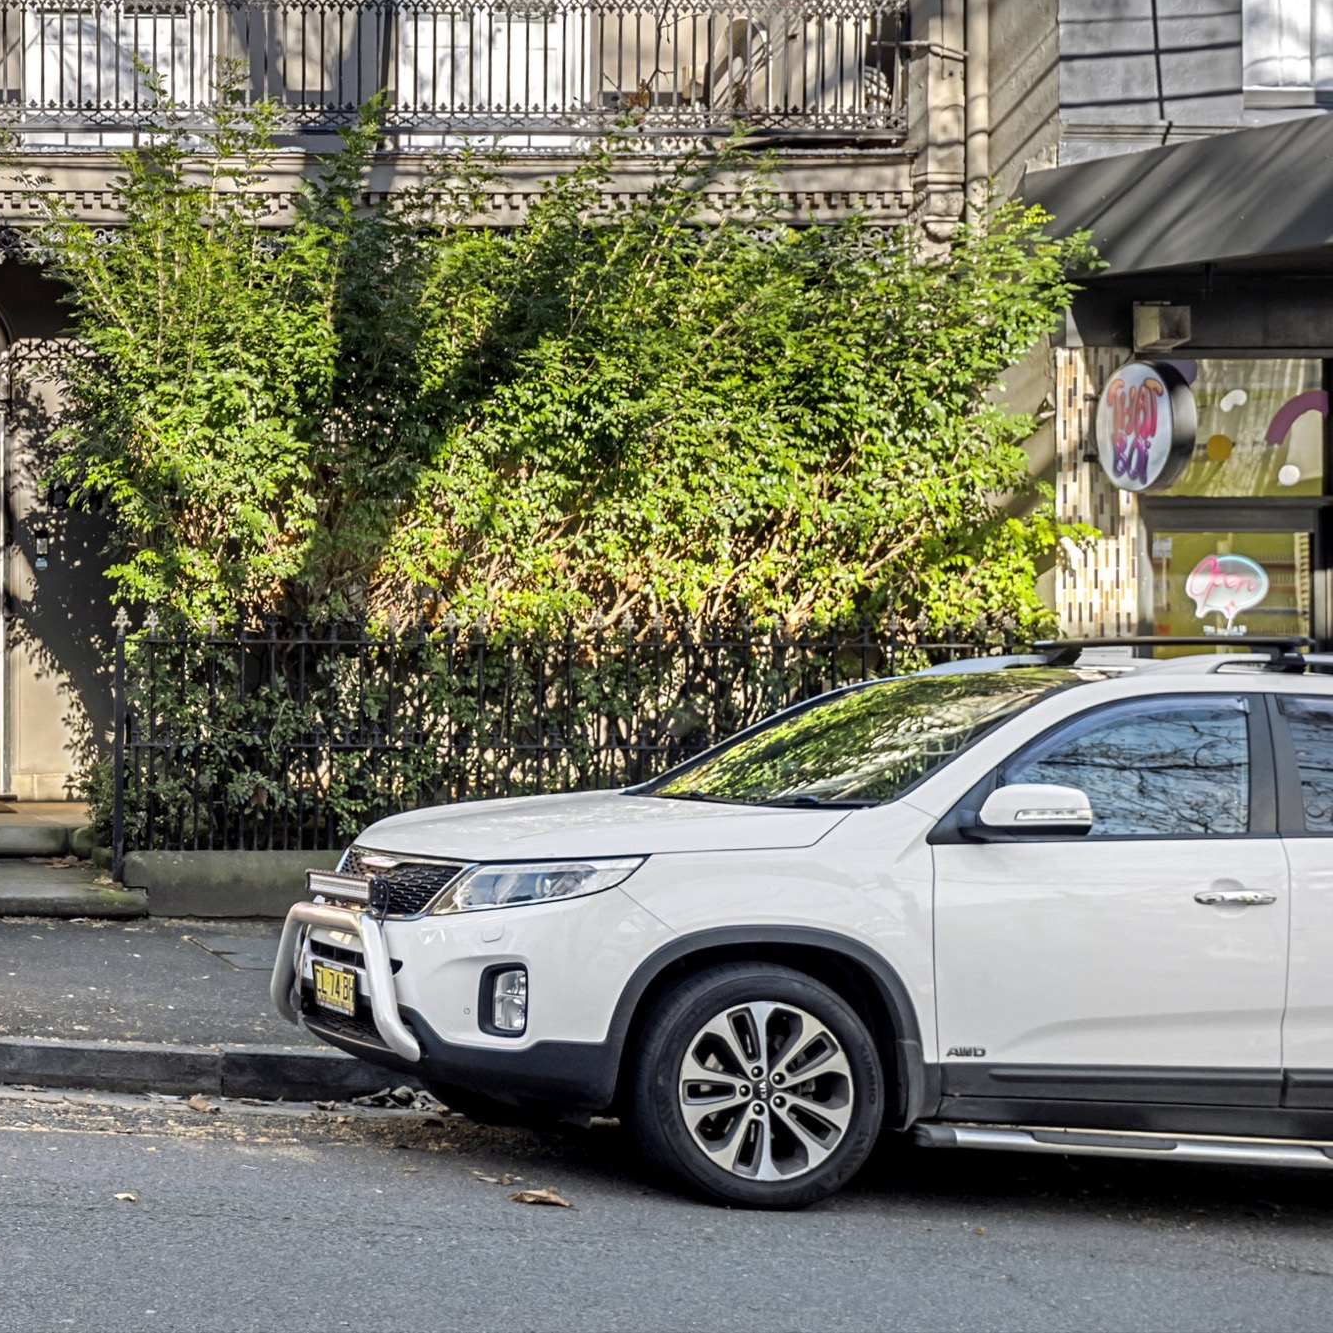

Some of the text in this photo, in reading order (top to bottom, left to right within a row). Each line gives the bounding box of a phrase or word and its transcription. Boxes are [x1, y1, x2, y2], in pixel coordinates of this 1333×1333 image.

[1106, 377, 1164, 440] THAT
[1189, 556, 1258, 612] Open
[946, 1046, 987, 1057] AWD
[758, 1081, 768, 1099] KIA
